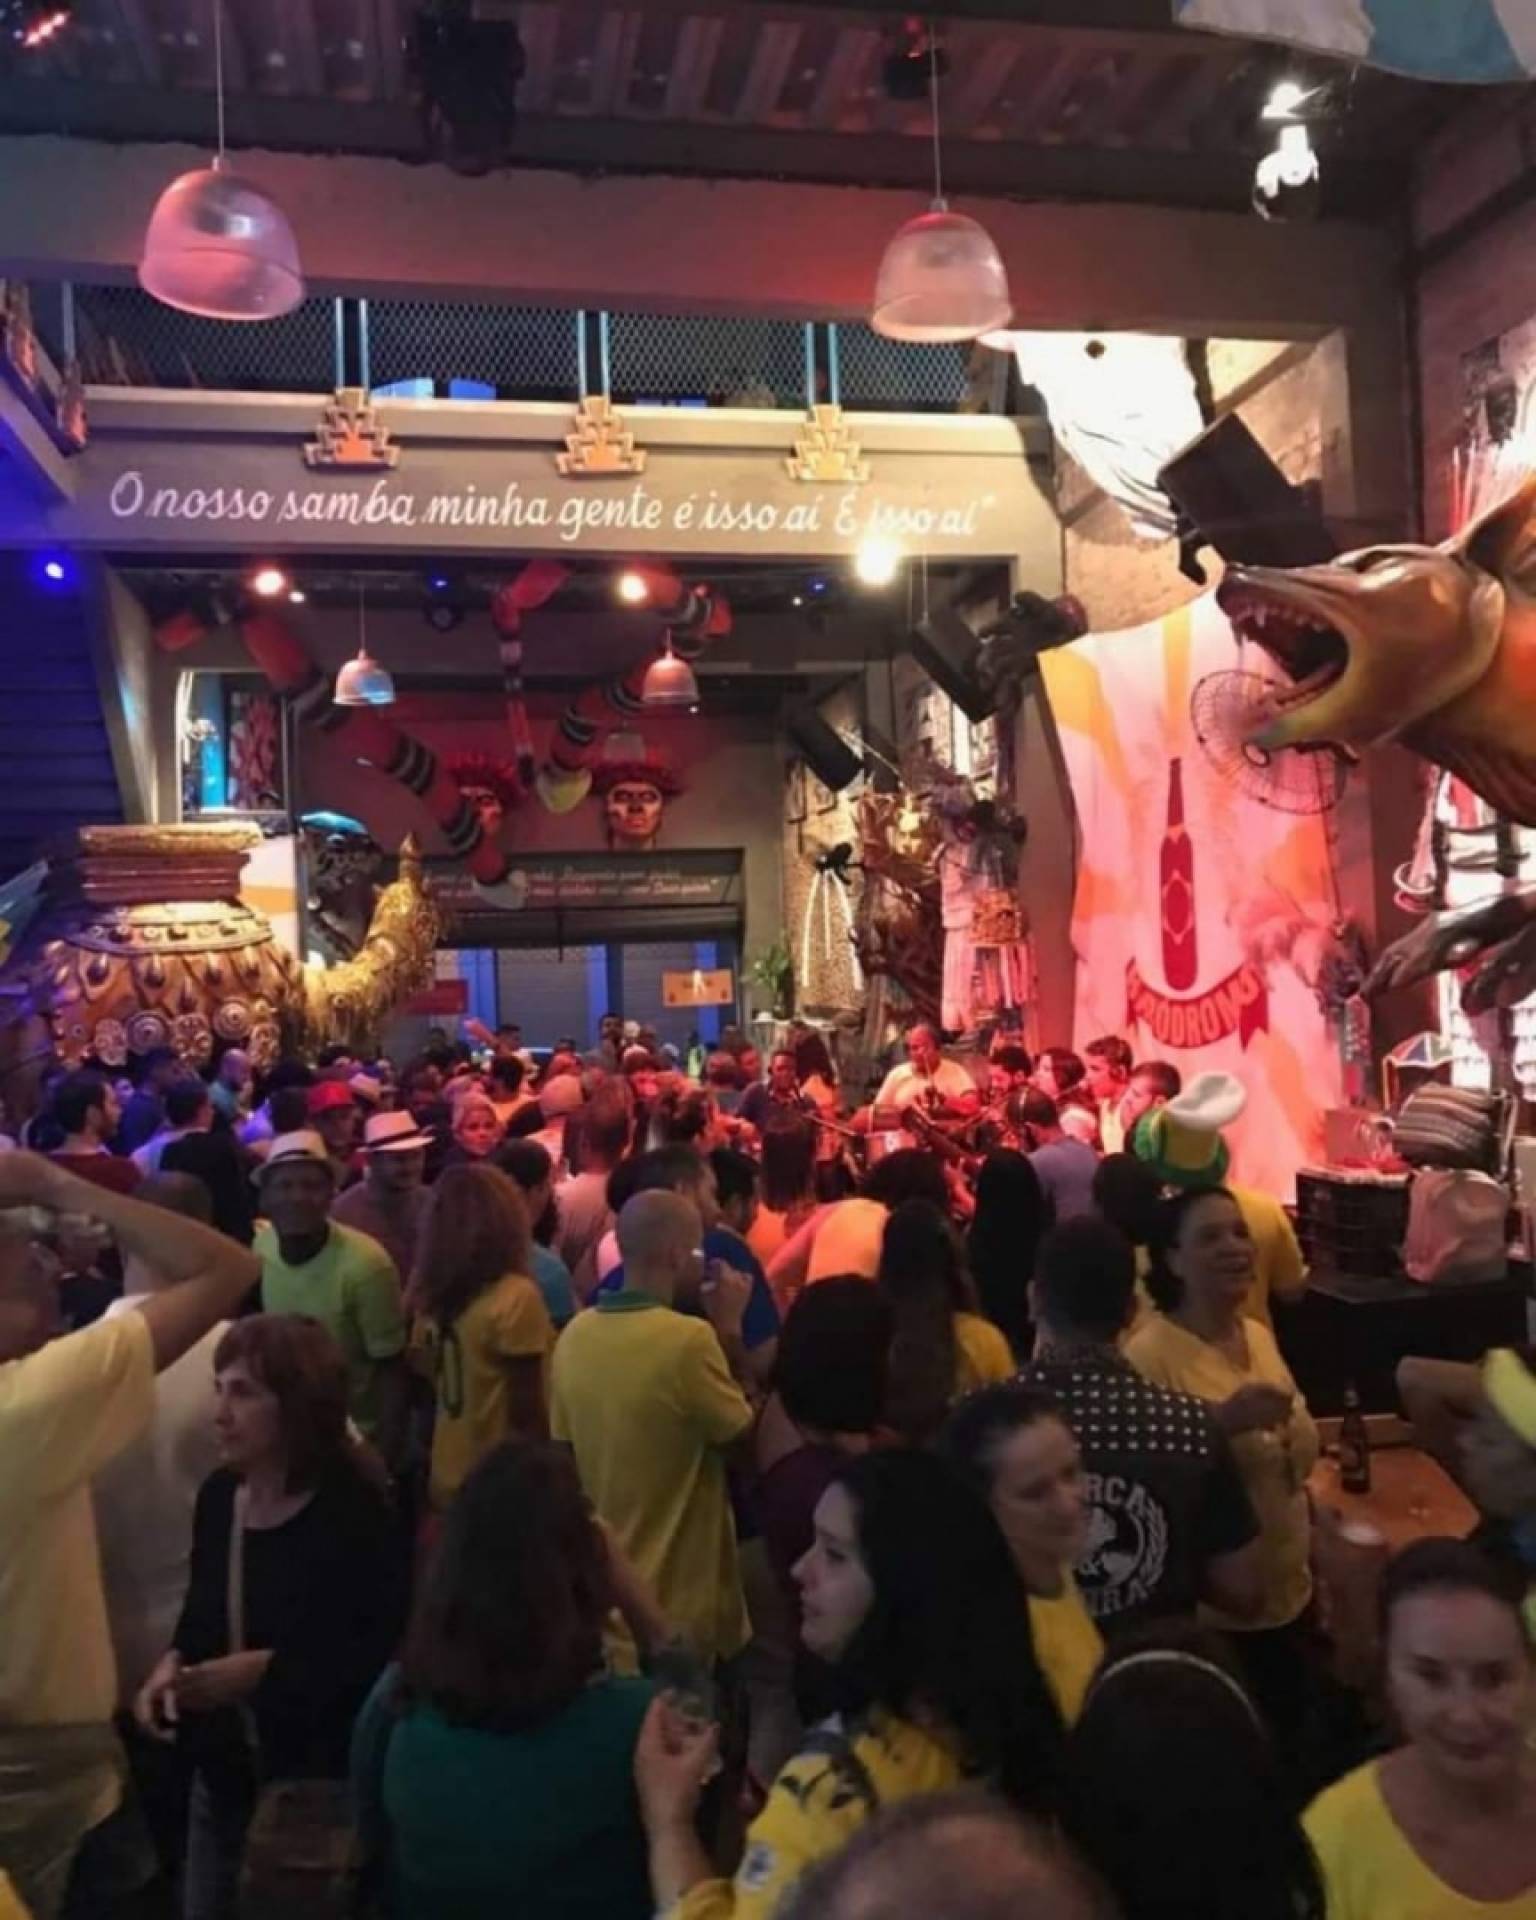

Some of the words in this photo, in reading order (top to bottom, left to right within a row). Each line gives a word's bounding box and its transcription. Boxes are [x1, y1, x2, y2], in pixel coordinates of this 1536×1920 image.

[111, 470, 144, 517] O
[147, 485, 273, 520] nosso
[277, 479, 416, 526] samba
[422, 482, 552, 526] minha
[558, 484, 662, 541] gente
[673, 493, 697, 529] é
[699, 490, 780, 531] isso
